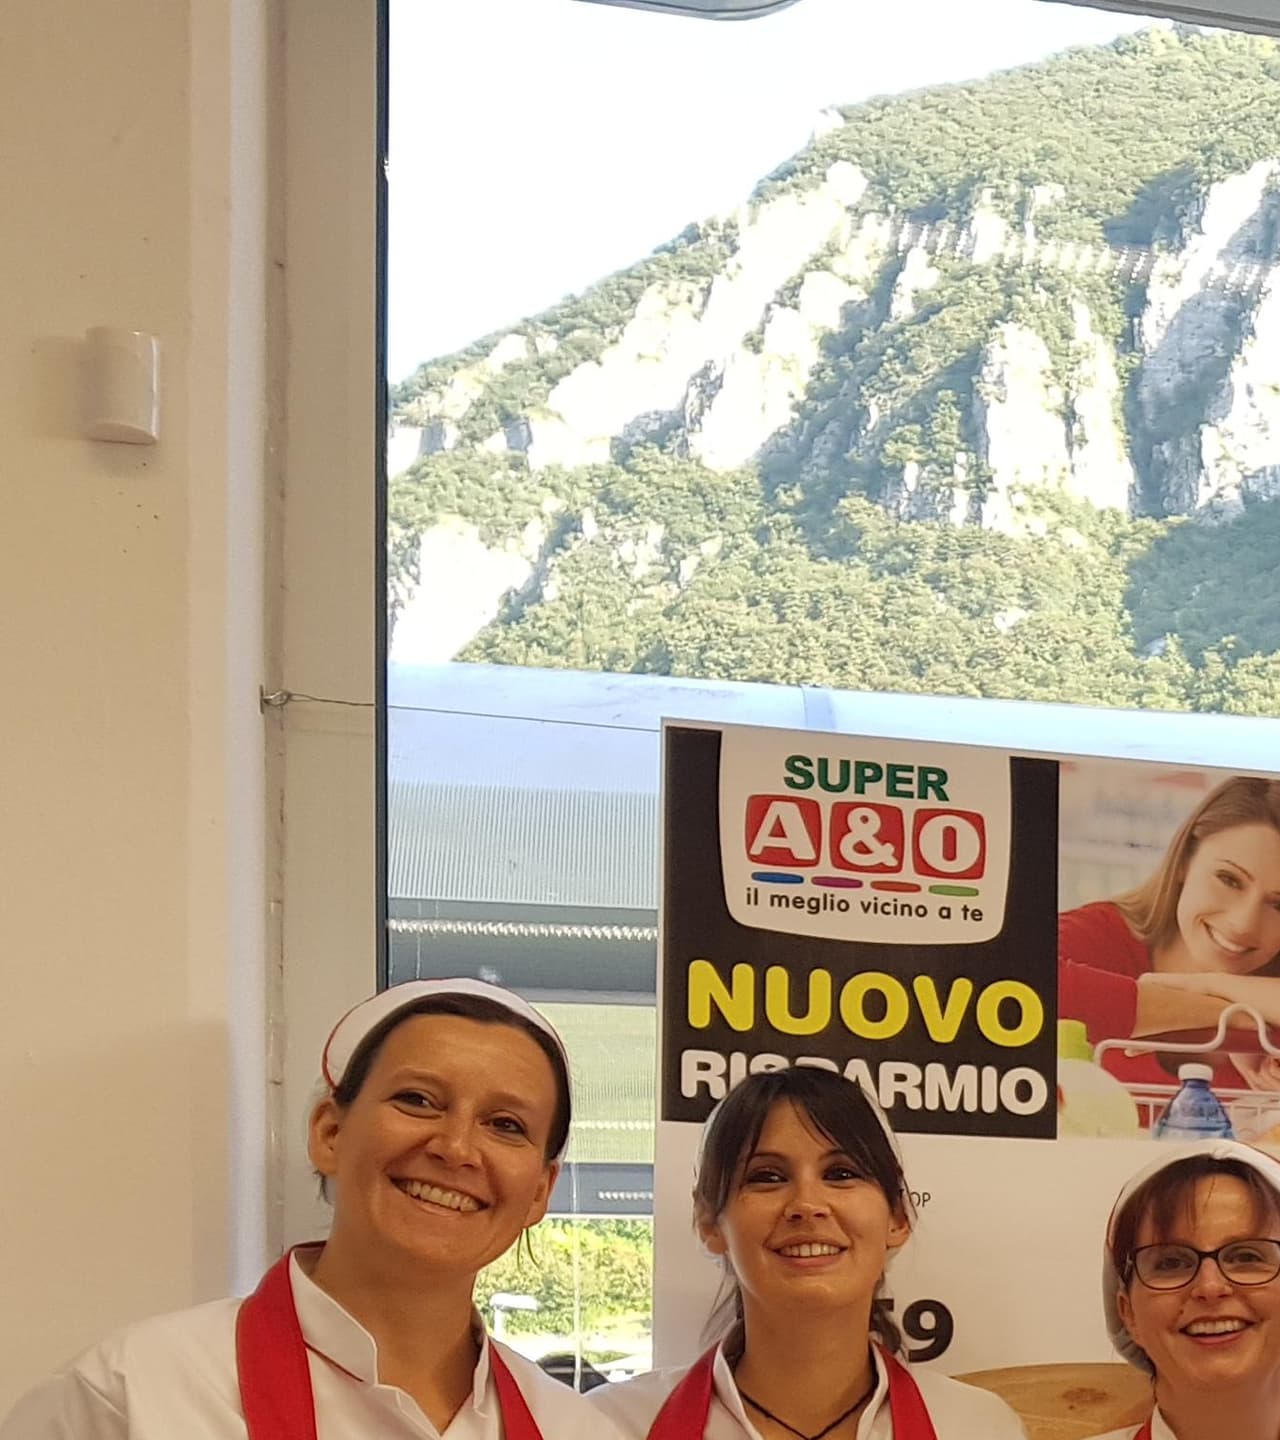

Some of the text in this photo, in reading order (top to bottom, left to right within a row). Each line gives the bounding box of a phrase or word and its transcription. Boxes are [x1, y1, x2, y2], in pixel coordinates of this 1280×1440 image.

[783, 754, 950, 802] SUPER
[748, 799, 982, 875] A&O
[746, 888, 984, 922] il meglio vicino a te
[687, 958, 1045, 1048] NUOVO
[680, 1048, 1049, 1116] RIARMIO
